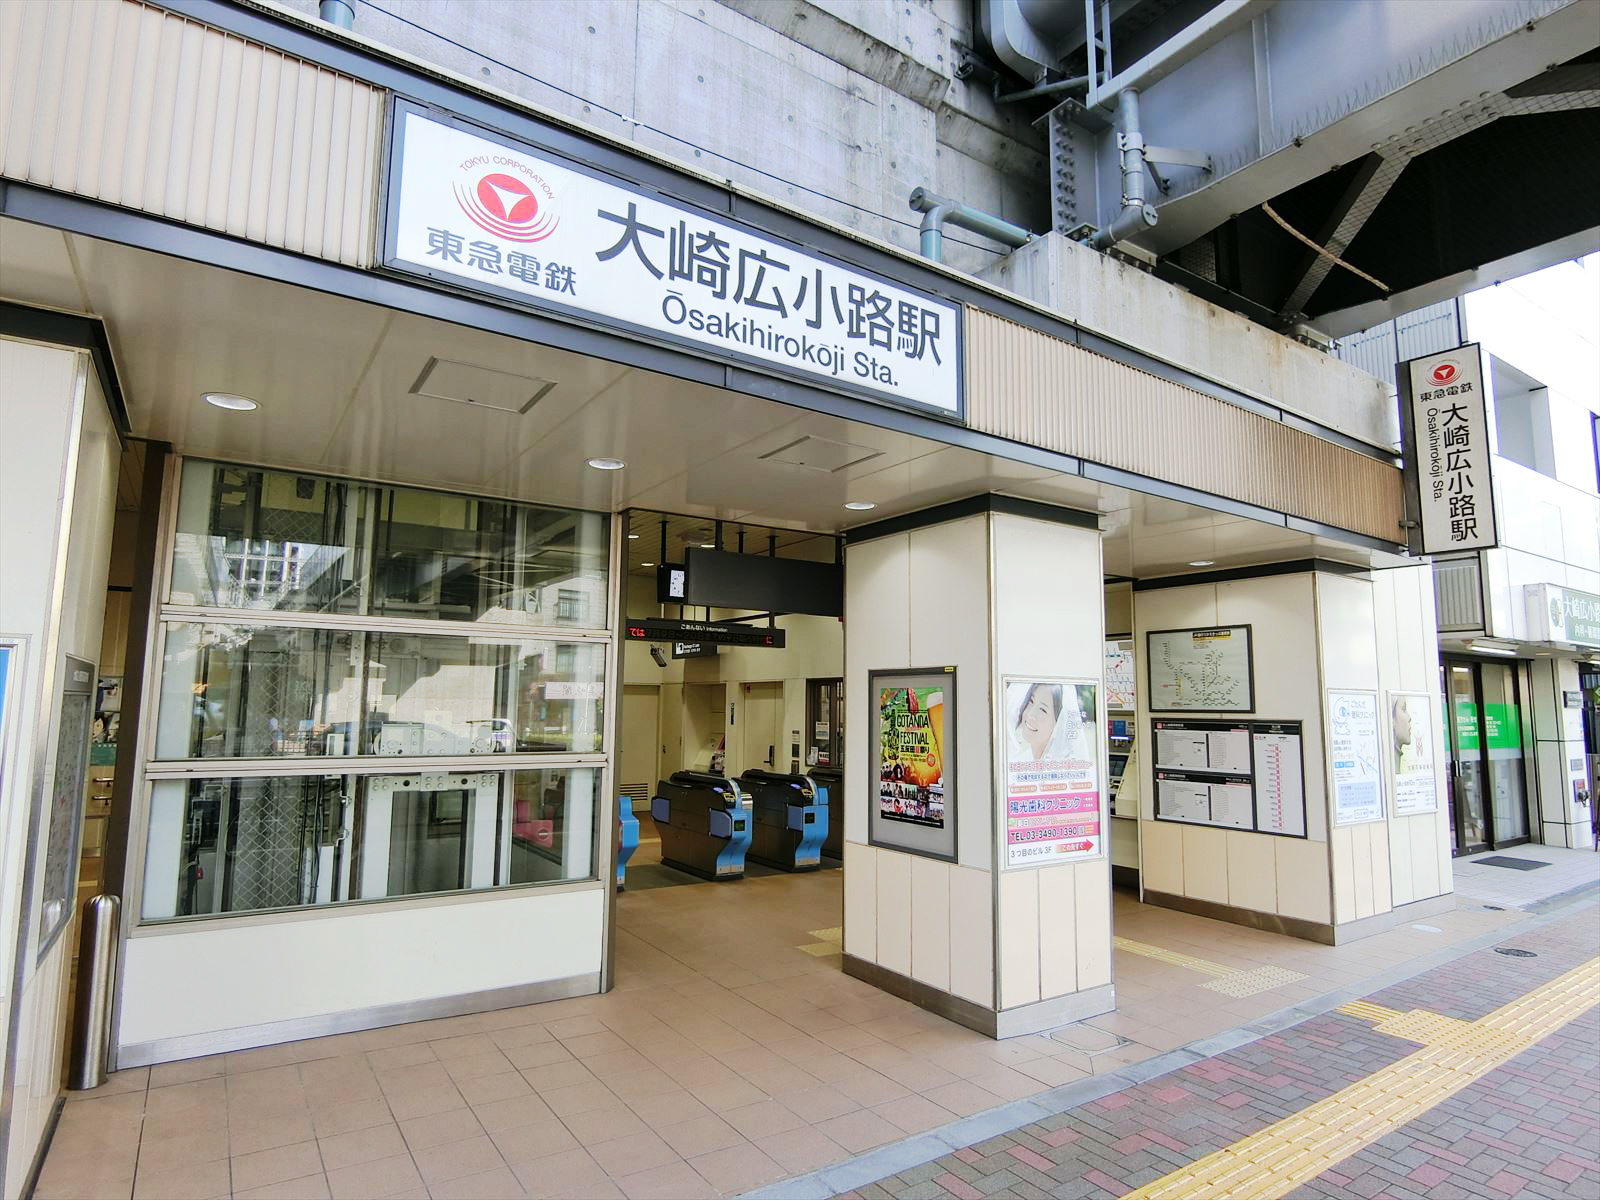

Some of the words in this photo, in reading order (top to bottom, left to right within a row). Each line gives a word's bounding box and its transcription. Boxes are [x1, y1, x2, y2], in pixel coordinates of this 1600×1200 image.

[459, 155, 490, 172] TOKYU
[492, 155, 555, 201] CORPORATION
[425, 226, 577, 297] 東急電鉄
[595, 201, 942, 367] 大崎広小路駅
[662, 288, 846, 373] Ōsakihirokōji
[853, 351, 899, 388] Sta.
[1420, 382, 1473, 402] 東急電鉄
[1427, 407, 1442, 478] Ōsakihirokōji
[1432, 479, 1444, 502] Sta.
[1441, 402, 1479, 542] 大崎広小路駅
[896, 714, 930, 728] GOTANDA
[900, 731, 930, 745] FESTIVAL
[1010, 797, 1081, 813] 陽光歯科クリニック
